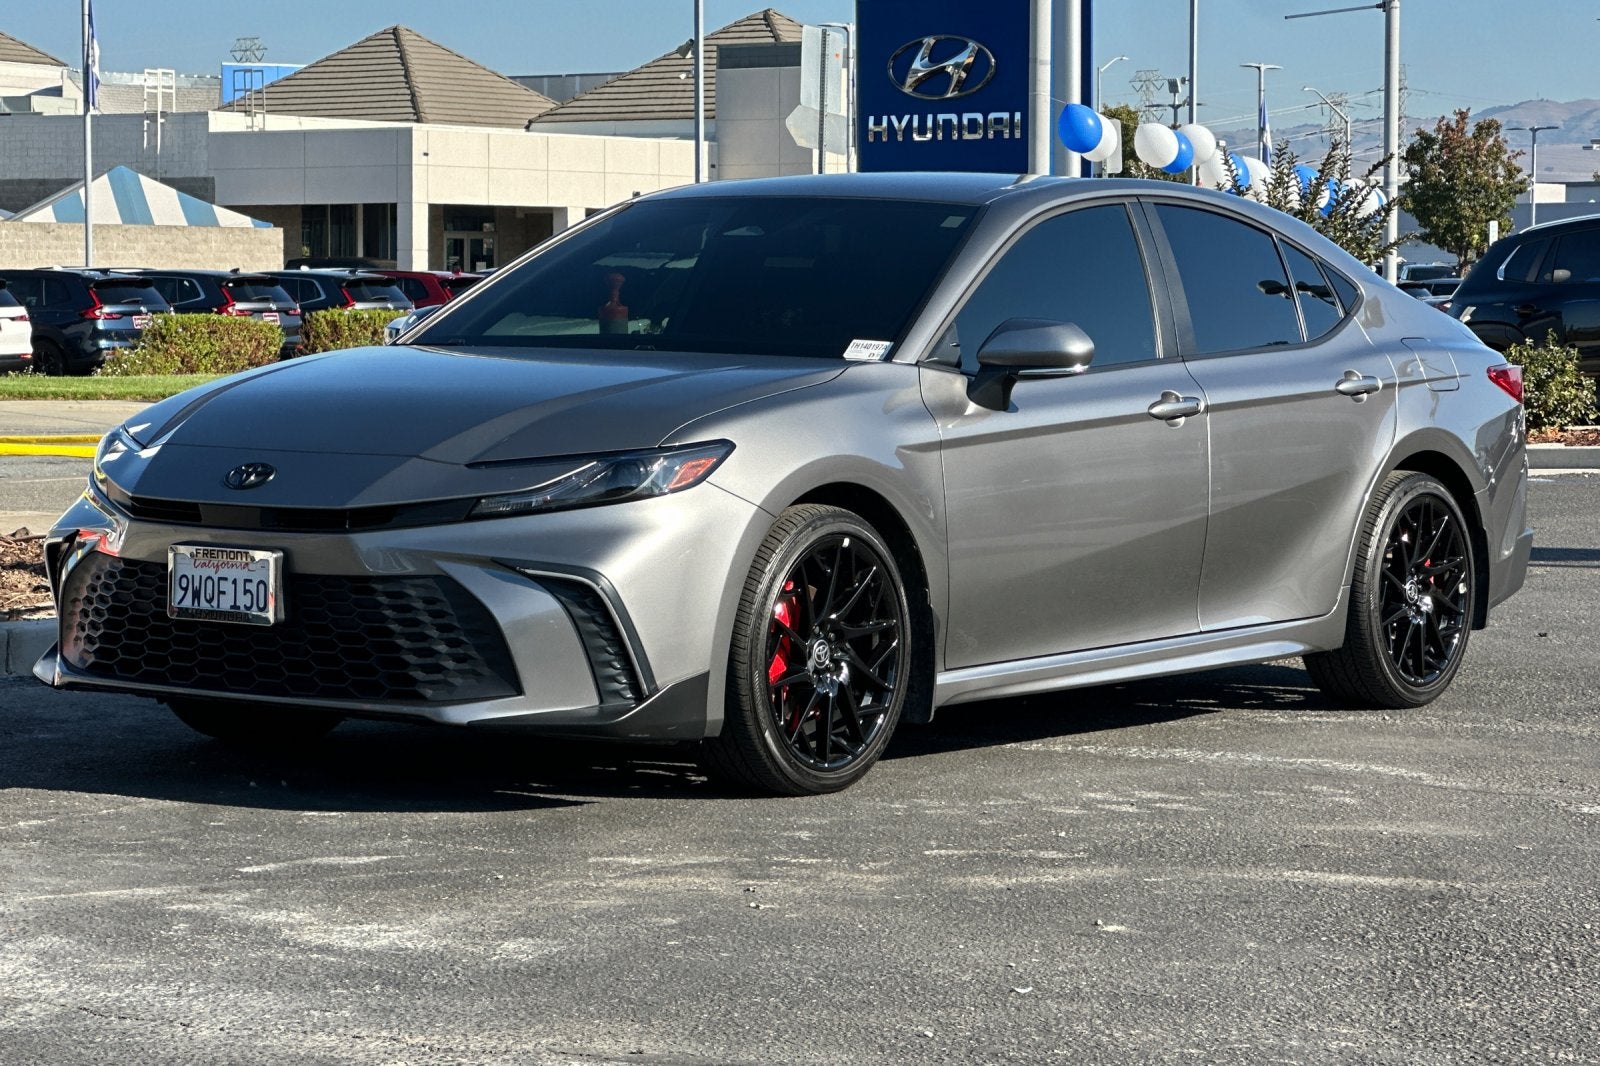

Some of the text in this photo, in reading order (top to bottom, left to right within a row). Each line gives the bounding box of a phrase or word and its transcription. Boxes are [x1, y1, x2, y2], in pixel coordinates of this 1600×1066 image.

[868, 112, 1021, 142] HYUNDAI
[195, 548, 250, 562] FREMONT
[193, 559, 256, 574] California
[177, 574, 268, 612] 9WQF150
